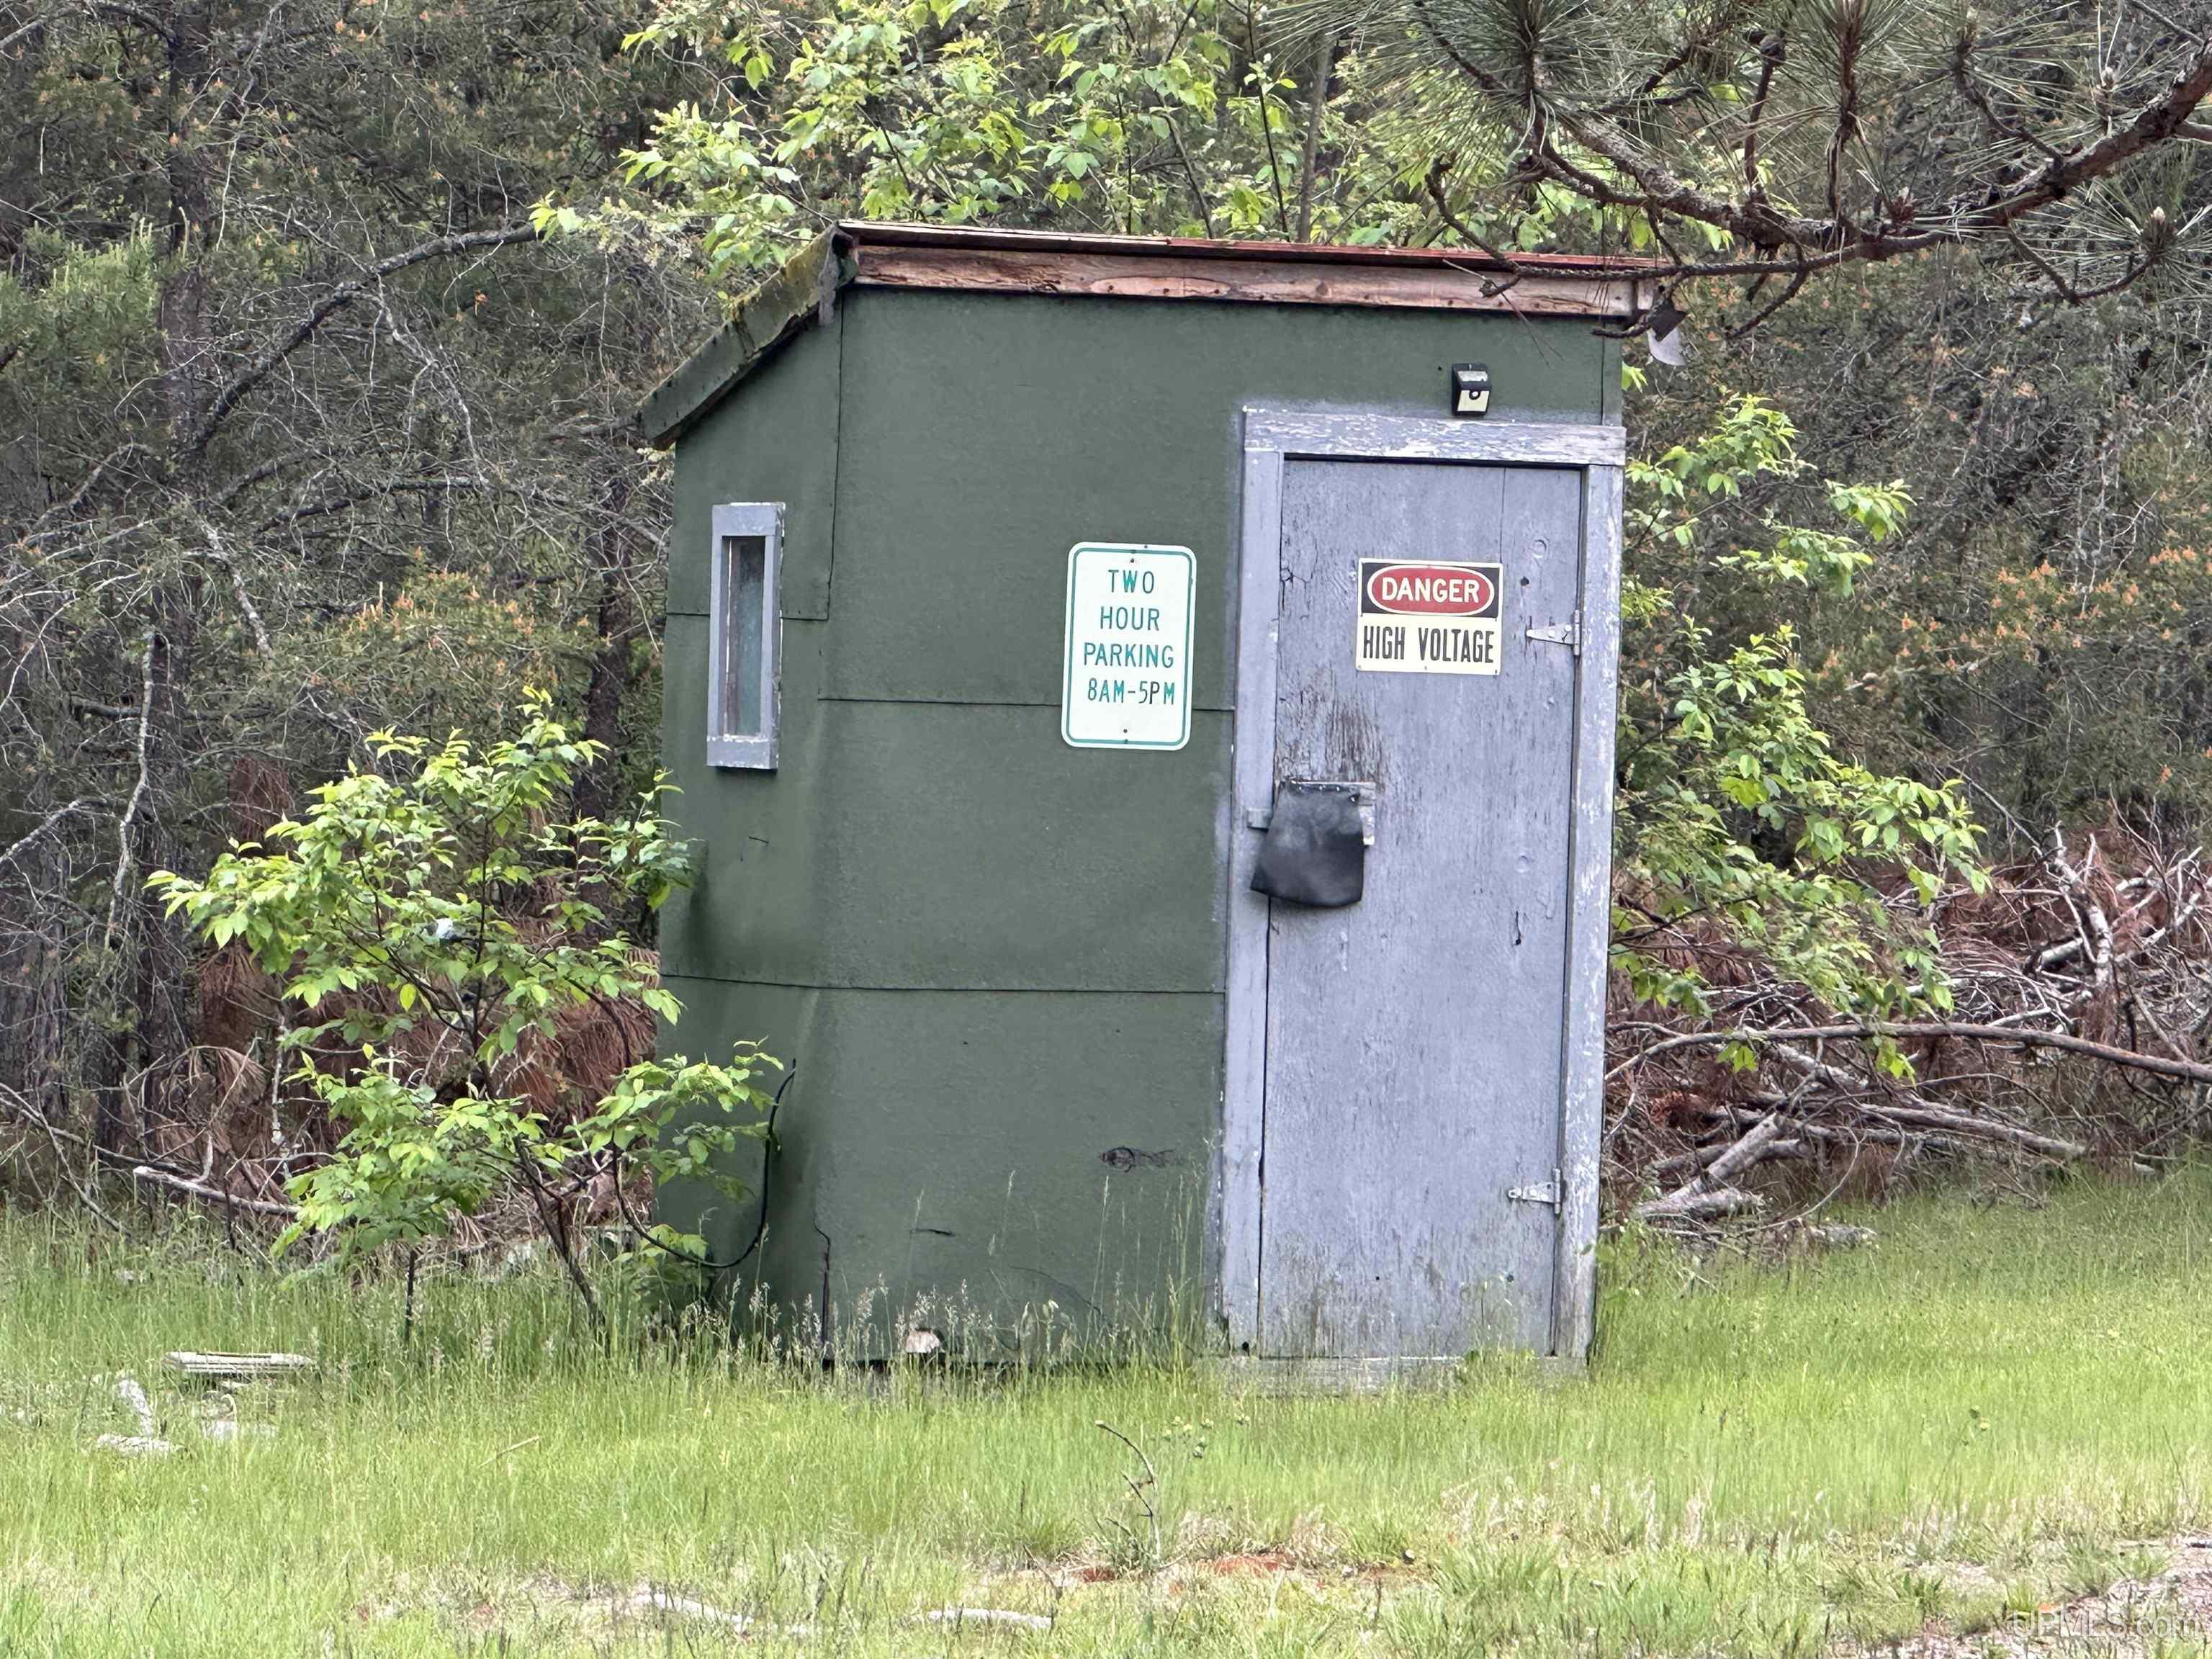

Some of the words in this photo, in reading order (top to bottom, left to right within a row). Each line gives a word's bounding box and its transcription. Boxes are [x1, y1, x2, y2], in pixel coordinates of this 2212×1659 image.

[1107, 569, 1155, 594] TWO
[1382, 577, 1480, 603] DANGER
[1100, 606, 1160, 631] HOUR
[1083, 642, 1174, 668] PARKING
[1362, 625, 1406, 660] HIGH
[1417, 626, 1495, 663] VOLTAGE
[1087, 678, 1175, 706] 8AM-5PM
